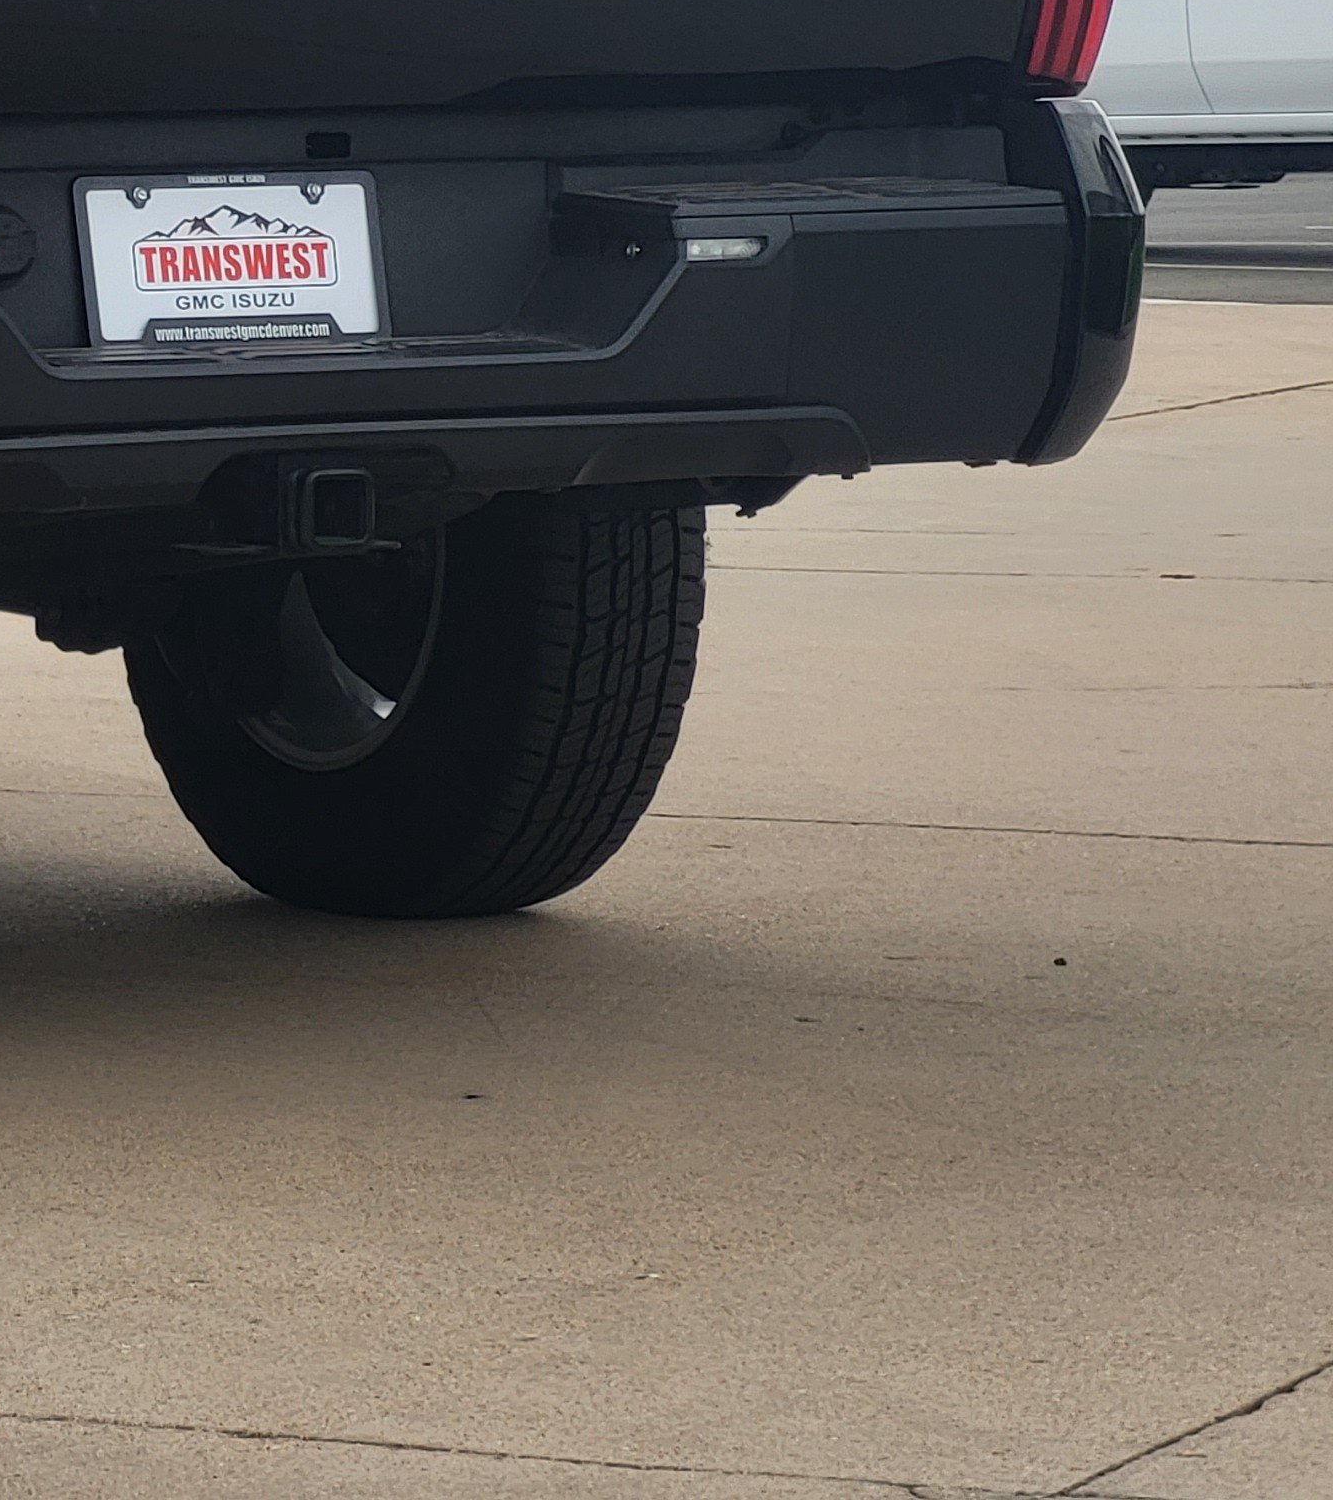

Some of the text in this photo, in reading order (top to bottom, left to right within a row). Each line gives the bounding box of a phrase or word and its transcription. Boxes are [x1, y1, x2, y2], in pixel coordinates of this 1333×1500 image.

[139, 242, 329, 283] TRANSWEST
[175, 292, 295, 311] GMC ISUZU
[153, 322, 331, 342] www.transwestgmcdenver.com
